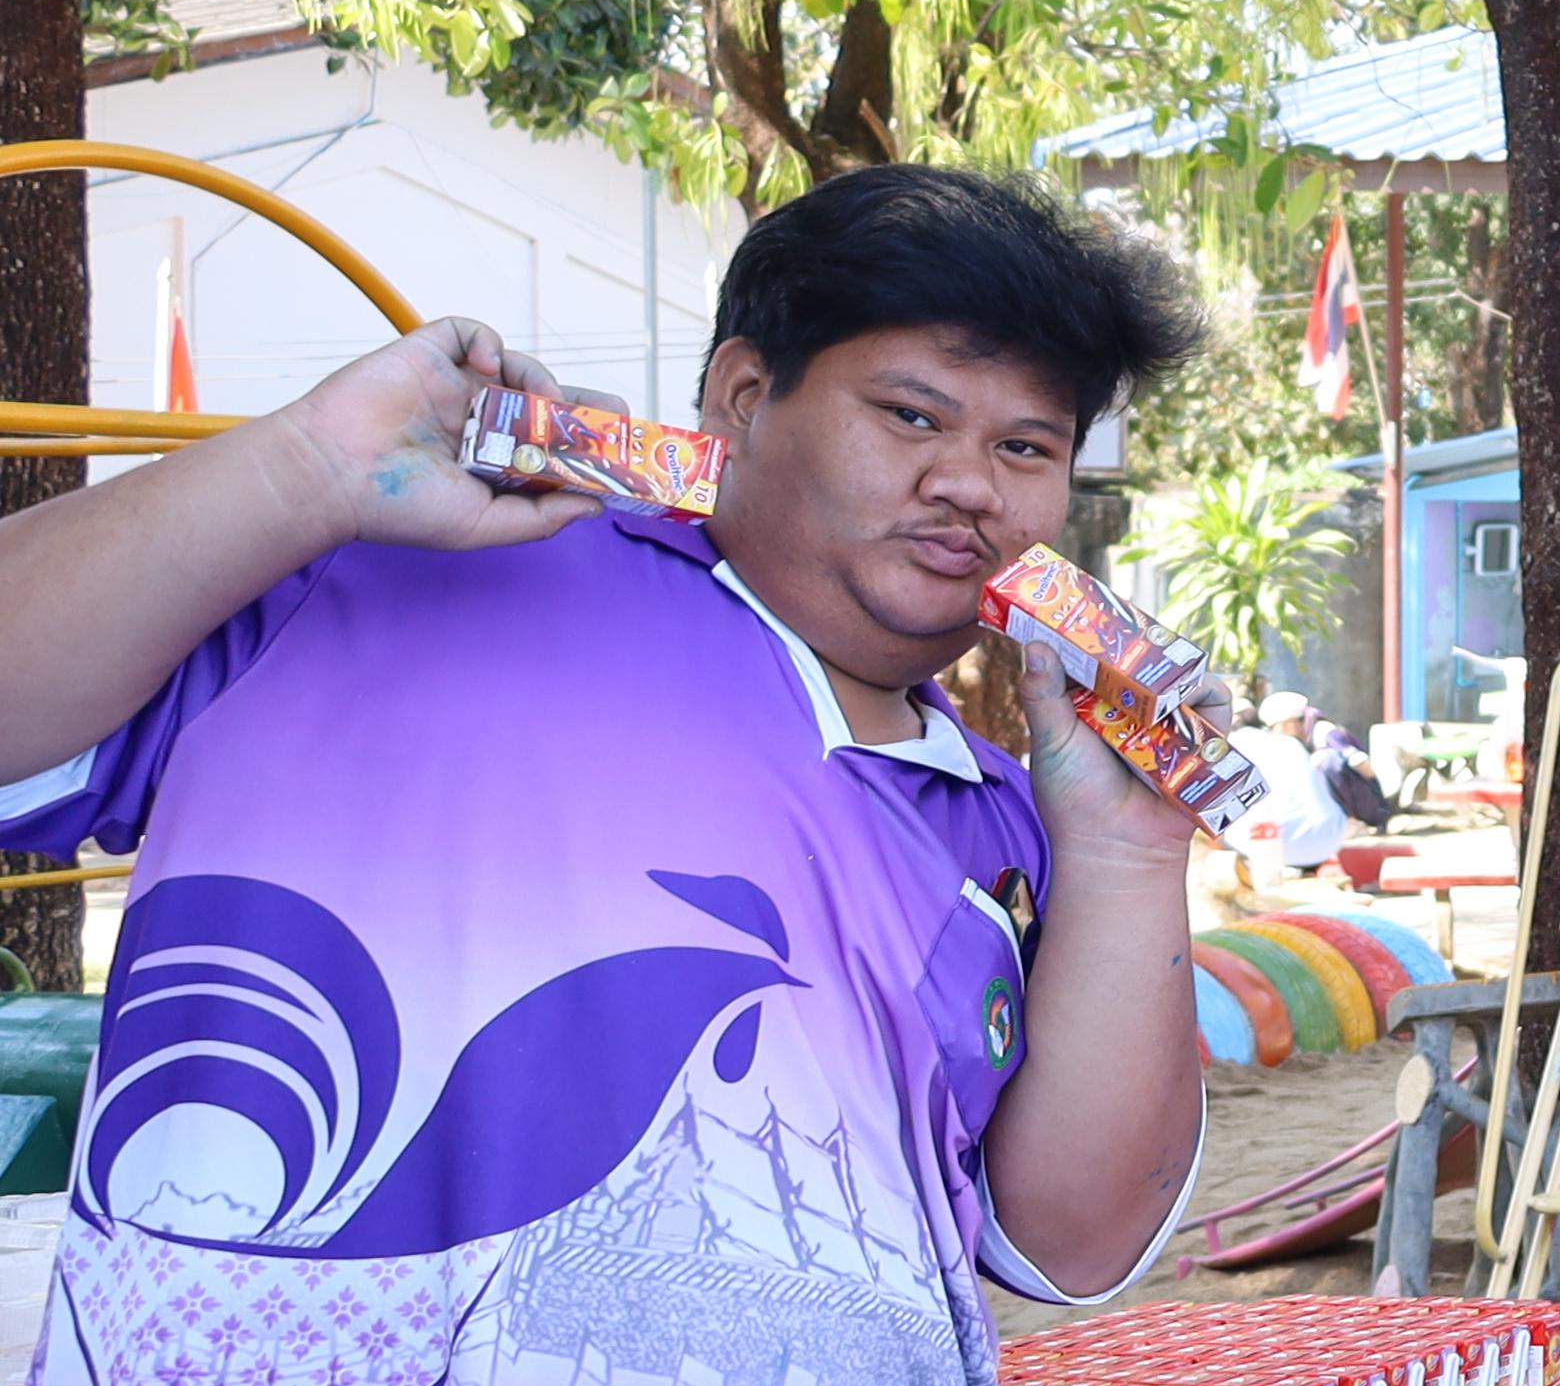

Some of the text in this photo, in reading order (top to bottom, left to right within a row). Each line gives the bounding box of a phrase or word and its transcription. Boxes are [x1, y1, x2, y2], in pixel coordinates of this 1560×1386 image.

[665, 444, 683, 492] Ovaltine
[695, 486, 709, 503] 10
[1028, 550, 1046, 563] 10
[1032, 560, 1058, 601] Ovaltine
